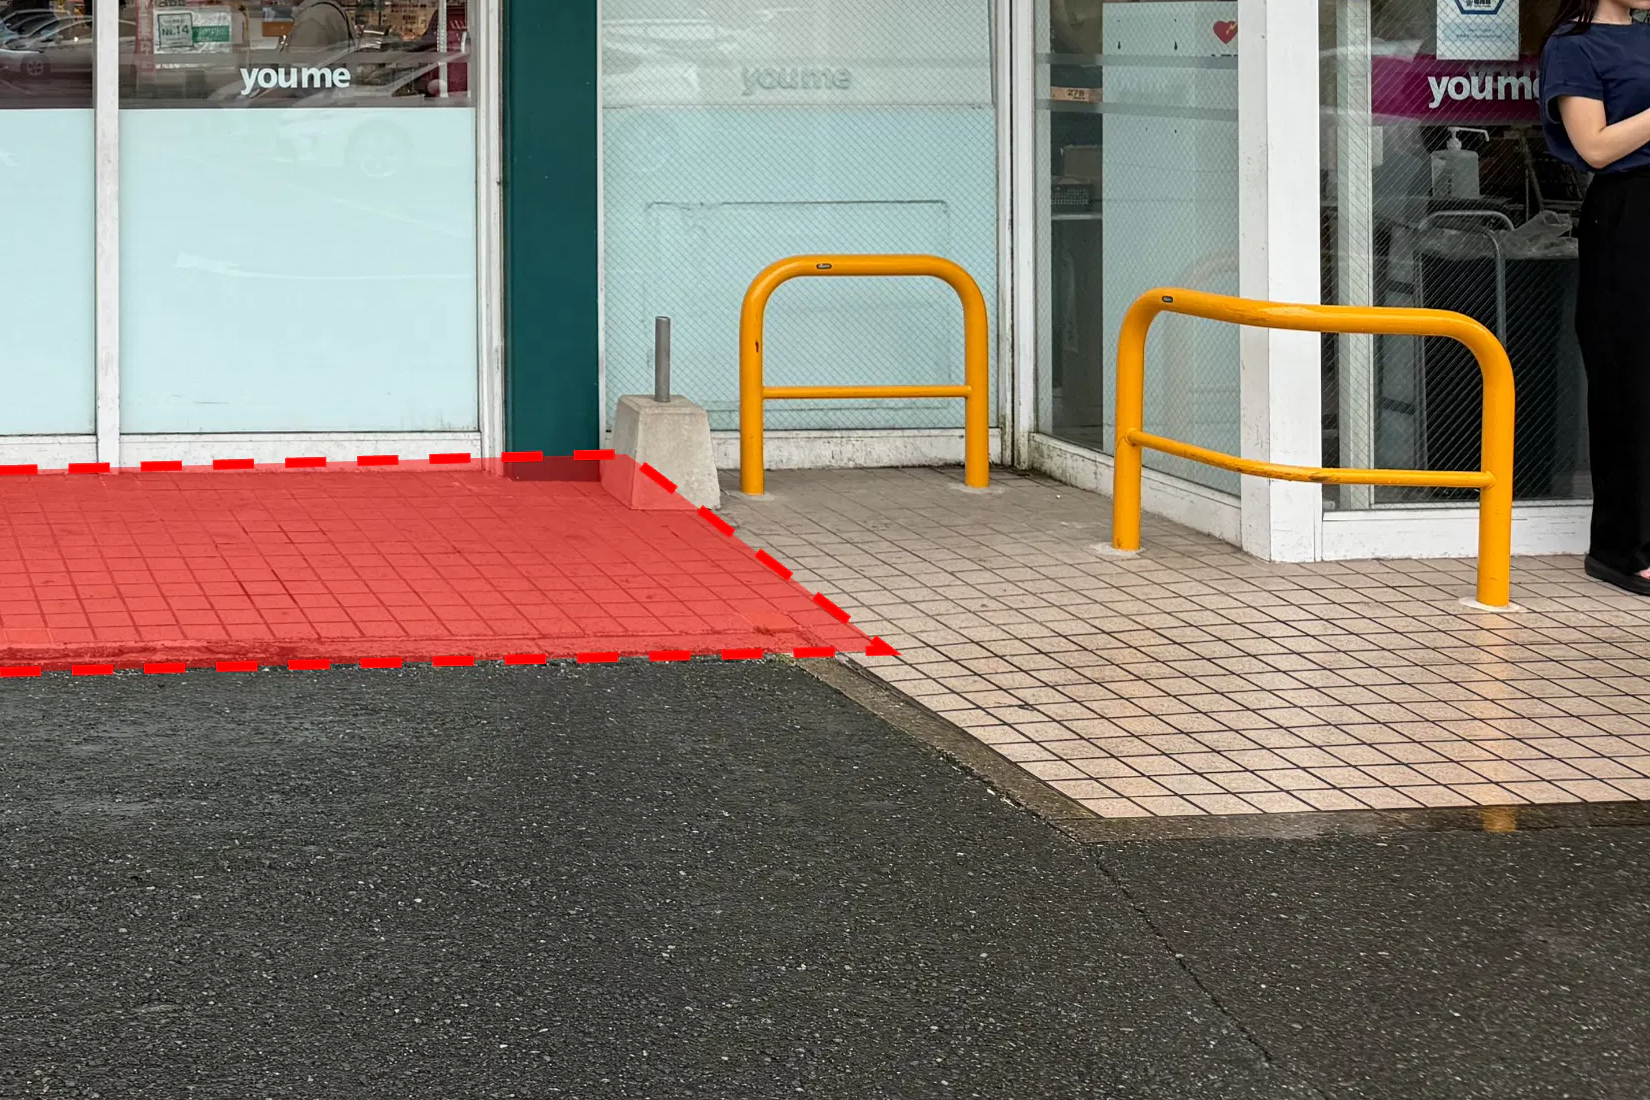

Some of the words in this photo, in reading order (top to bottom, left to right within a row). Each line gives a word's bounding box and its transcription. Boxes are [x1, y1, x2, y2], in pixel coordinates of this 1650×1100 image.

[239, 66, 351, 96] youme
[740, 65, 851, 98] youme
[1427, 75, 1540, 109] youm
